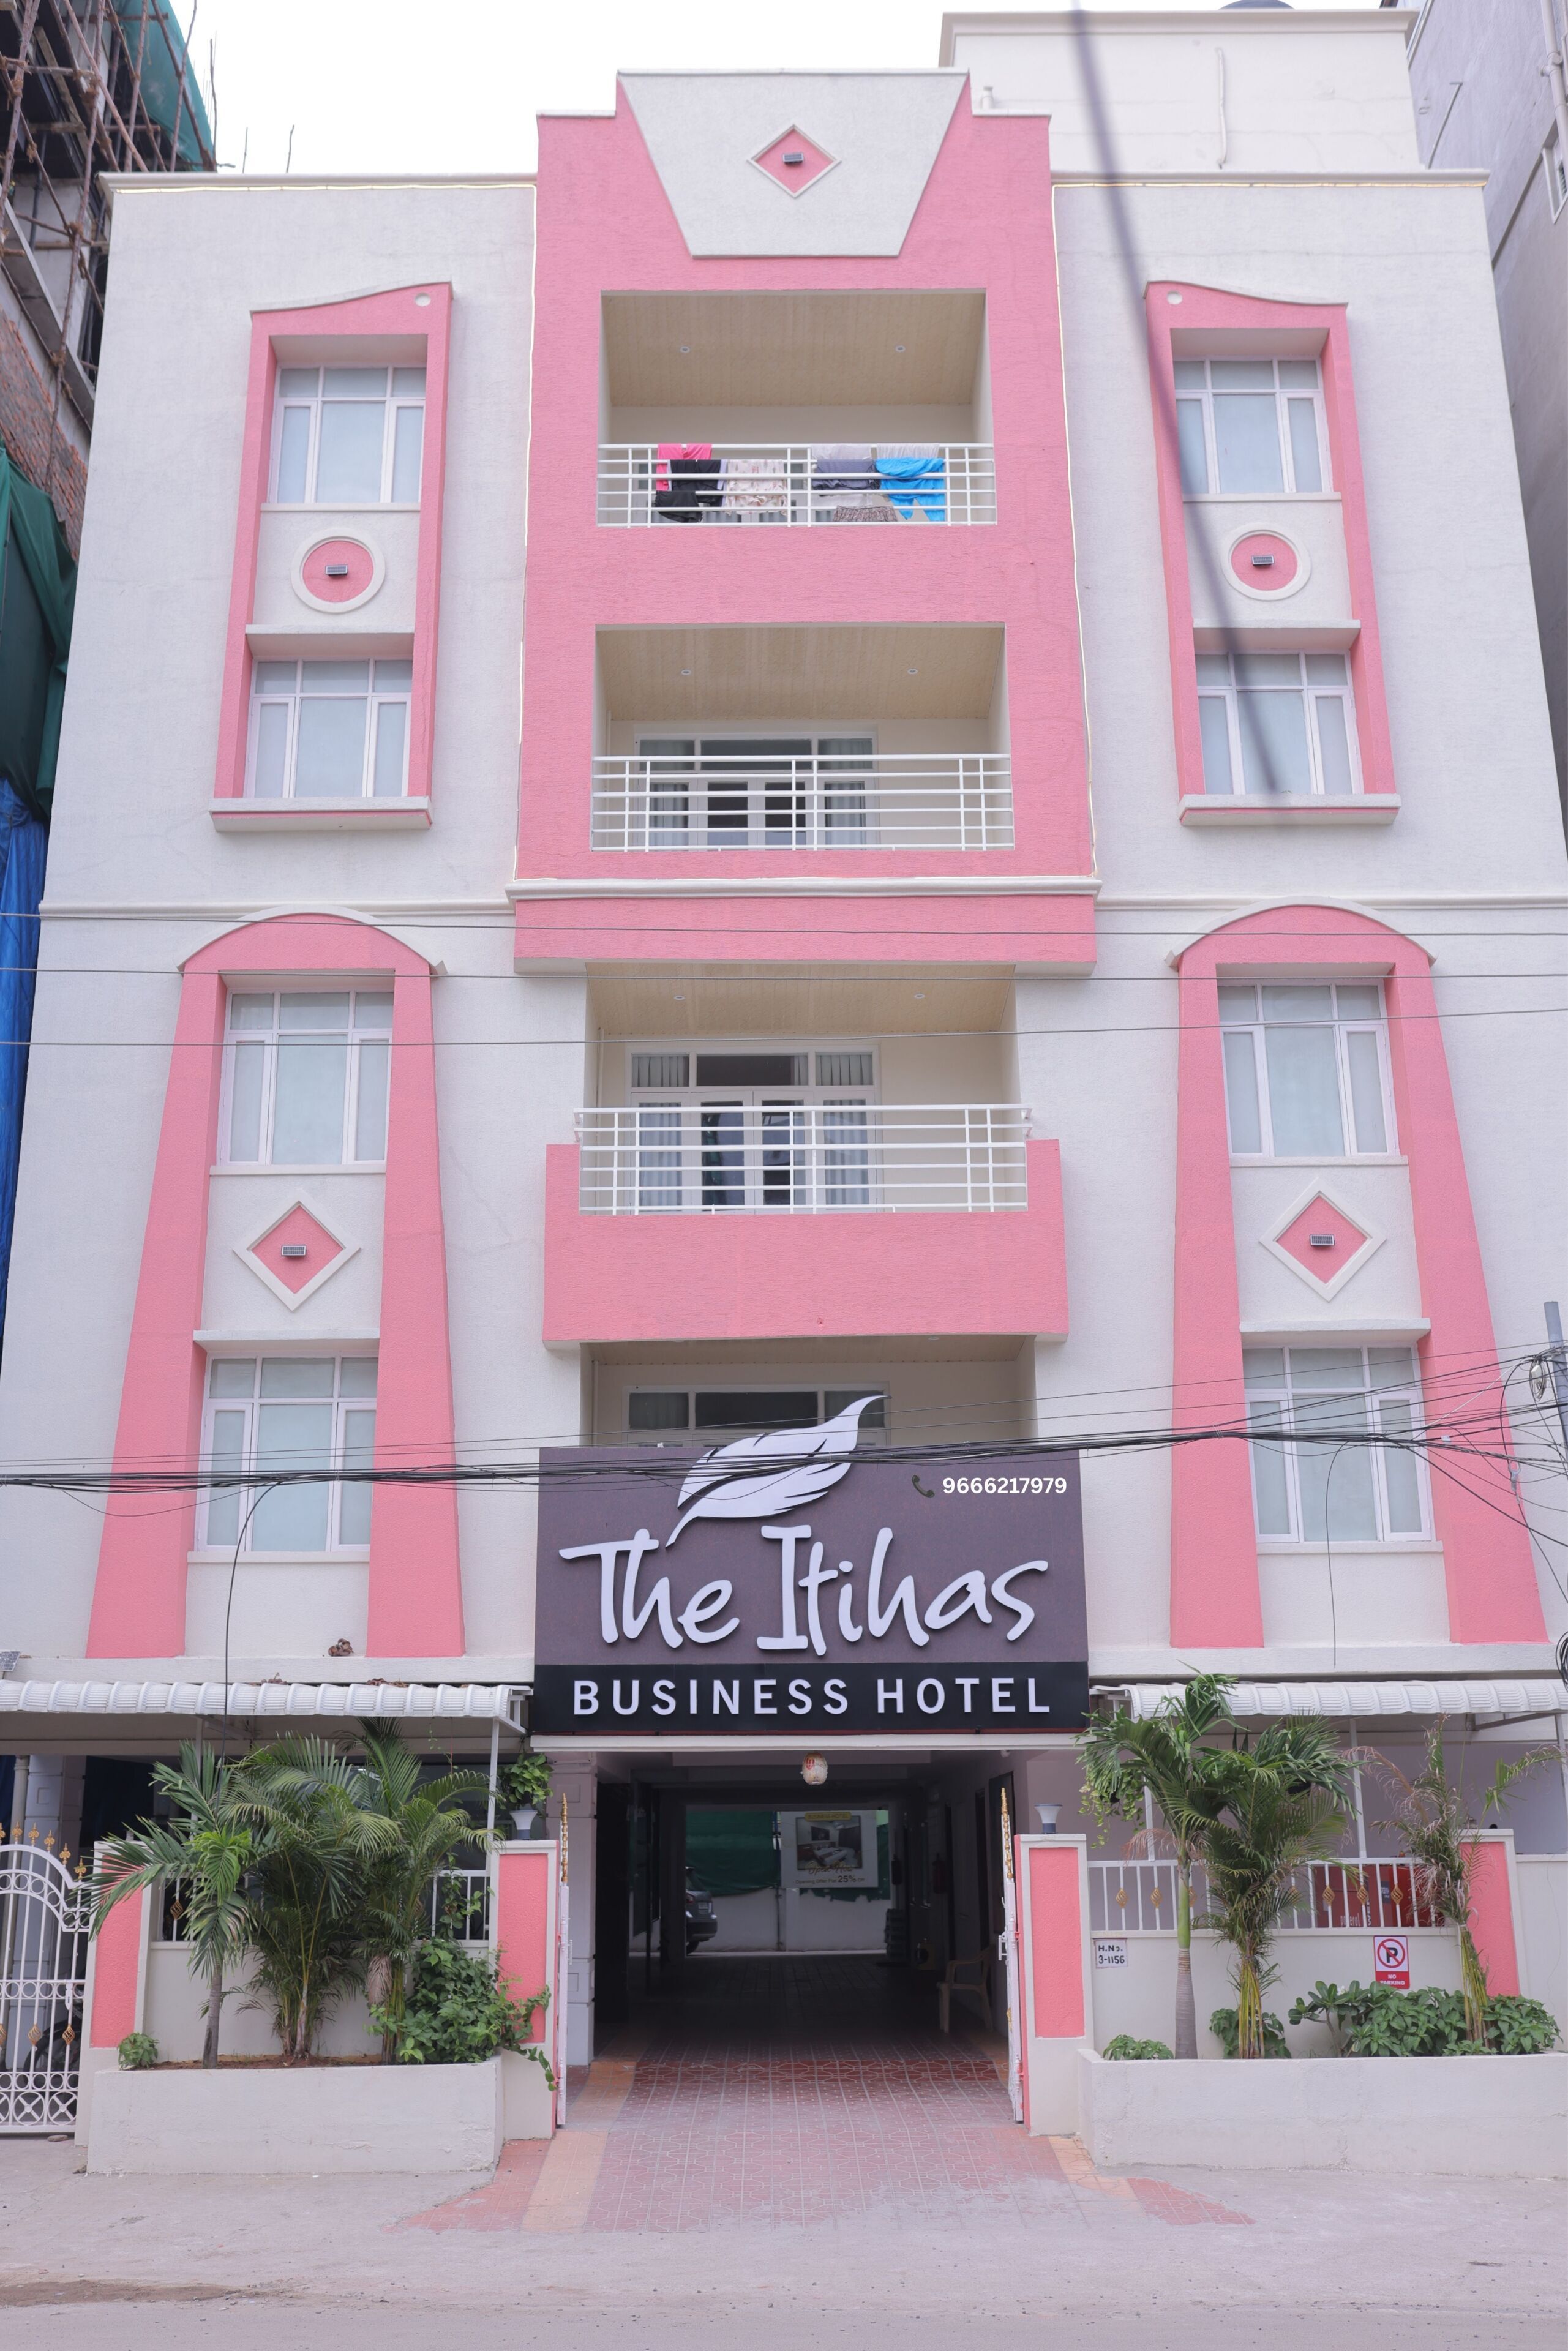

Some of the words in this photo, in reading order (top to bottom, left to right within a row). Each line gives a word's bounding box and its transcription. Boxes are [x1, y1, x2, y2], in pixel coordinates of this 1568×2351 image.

[559, 1529, 739, 1648] The
[757, 1525, 1048, 1655] Itihas
[574, 1679, 847, 1715] BUSINESS
[877, 1678, 1049, 1713] HOTEL
[1098, 1955, 1125, 1964] 3-1156
